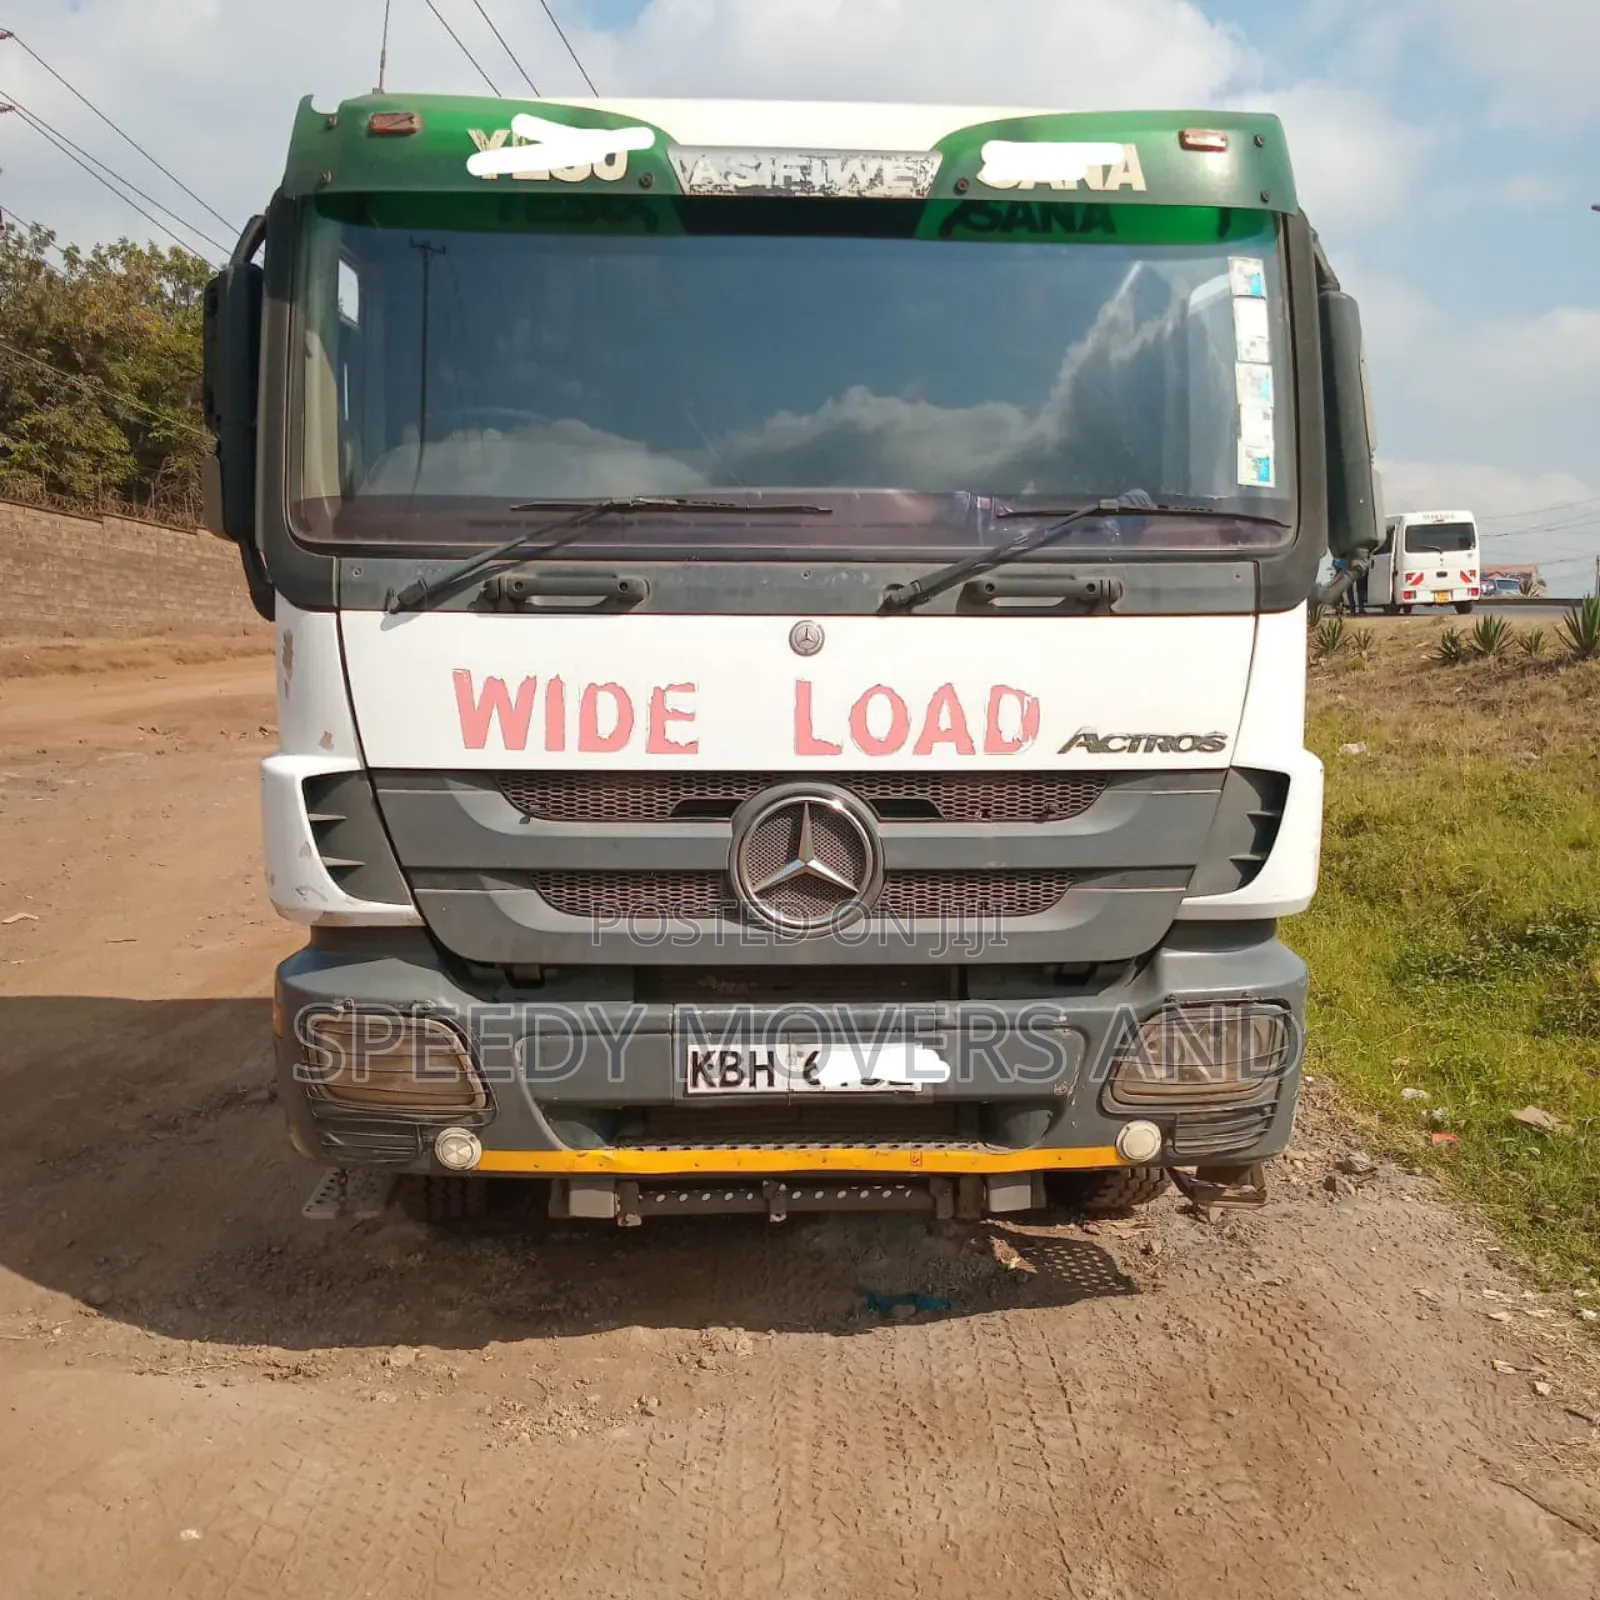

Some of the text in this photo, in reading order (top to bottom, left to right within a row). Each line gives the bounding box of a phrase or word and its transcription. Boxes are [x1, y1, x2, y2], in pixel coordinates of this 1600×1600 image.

[452, 668, 1040, 756] WIDE LOAD
[1057, 726, 1228, 755] ACTROS
[690, 1050, 775, 1088] KBH
